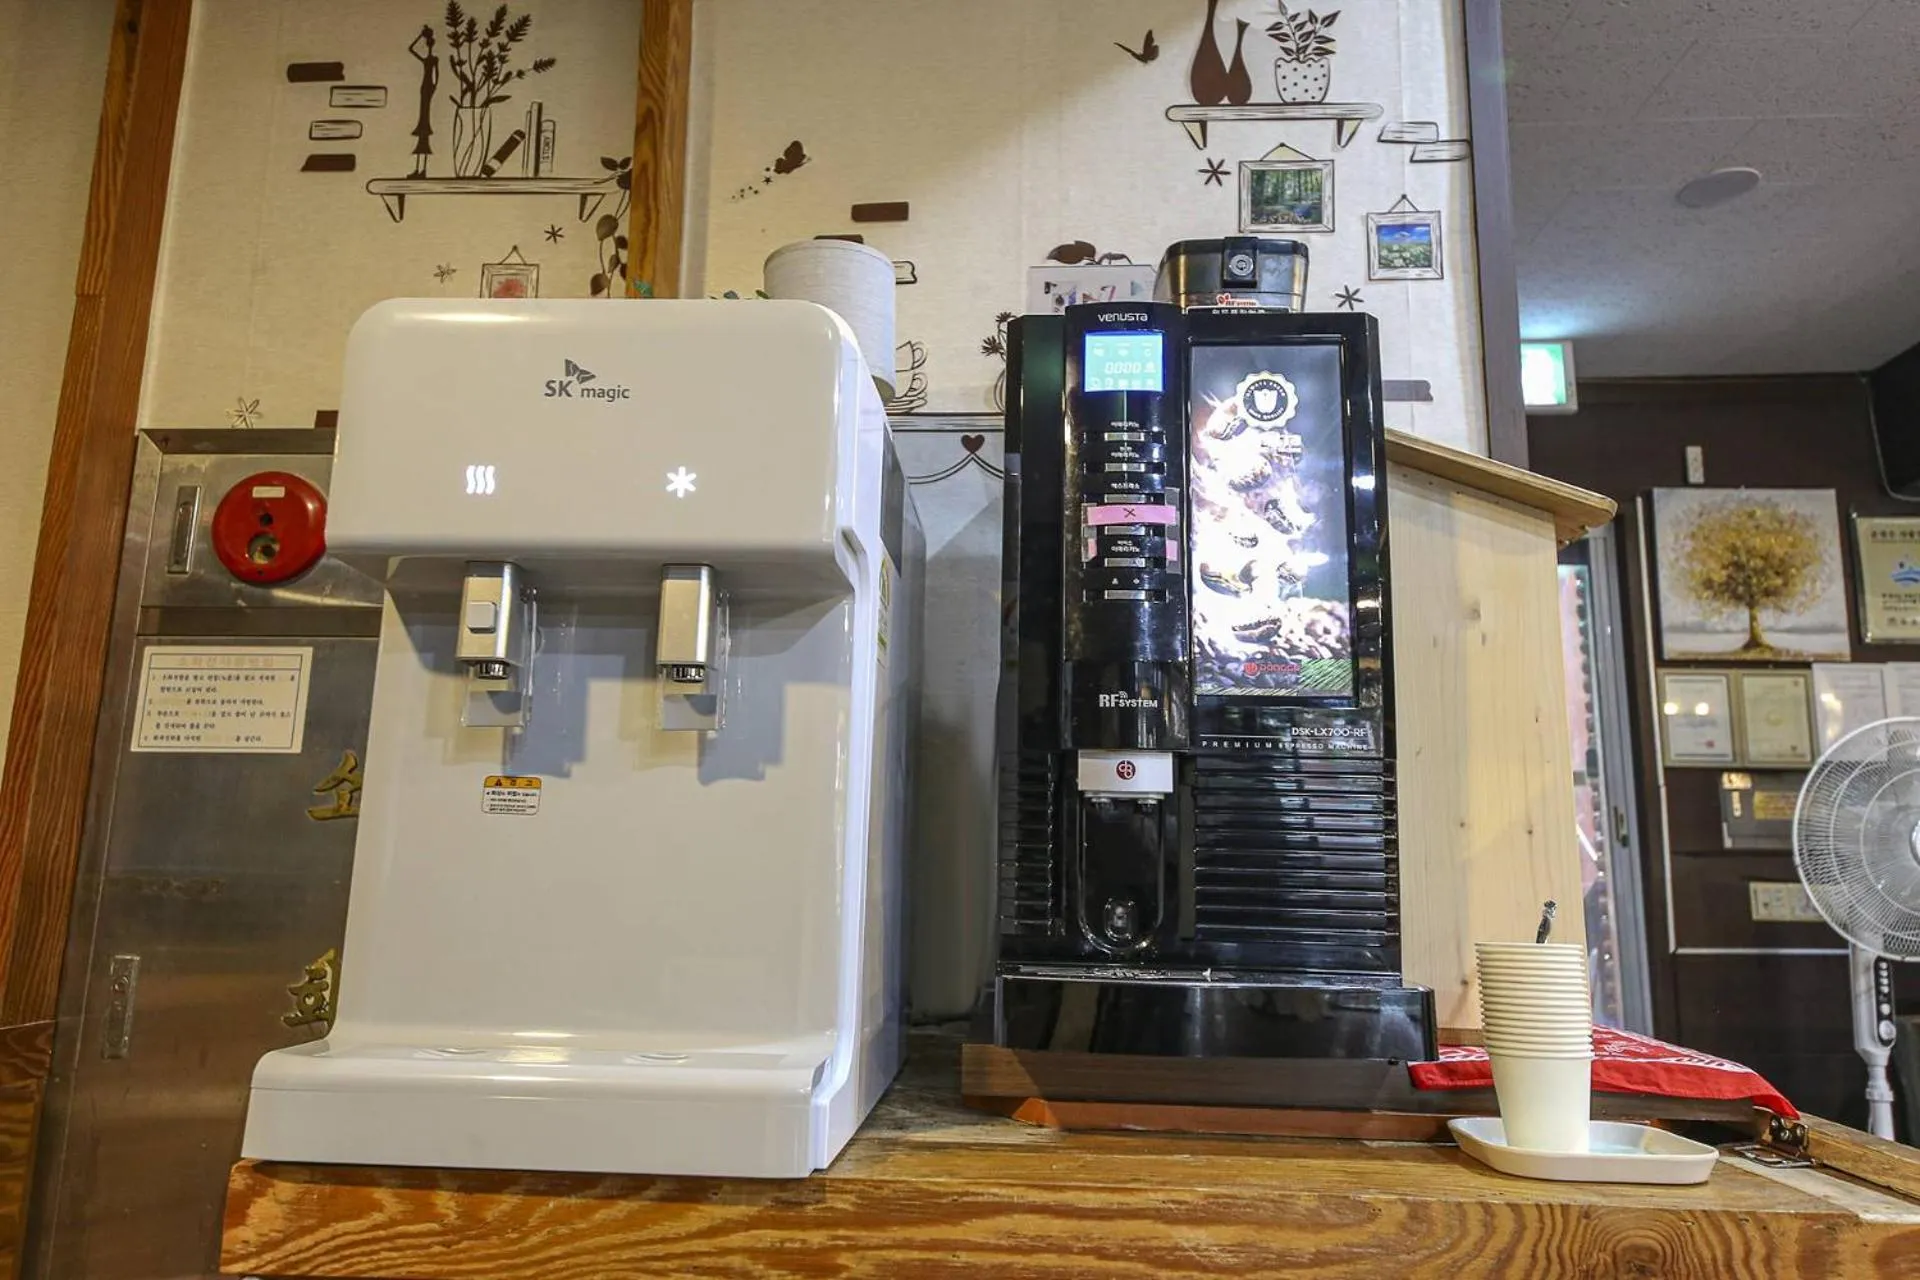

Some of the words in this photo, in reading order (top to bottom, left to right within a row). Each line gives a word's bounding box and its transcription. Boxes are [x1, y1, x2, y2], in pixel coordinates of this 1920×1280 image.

[543, 379, 573, 398] SK
[580, 384, 631, 403] magic
[1118, 699, 1158, 708] SYSTEM
